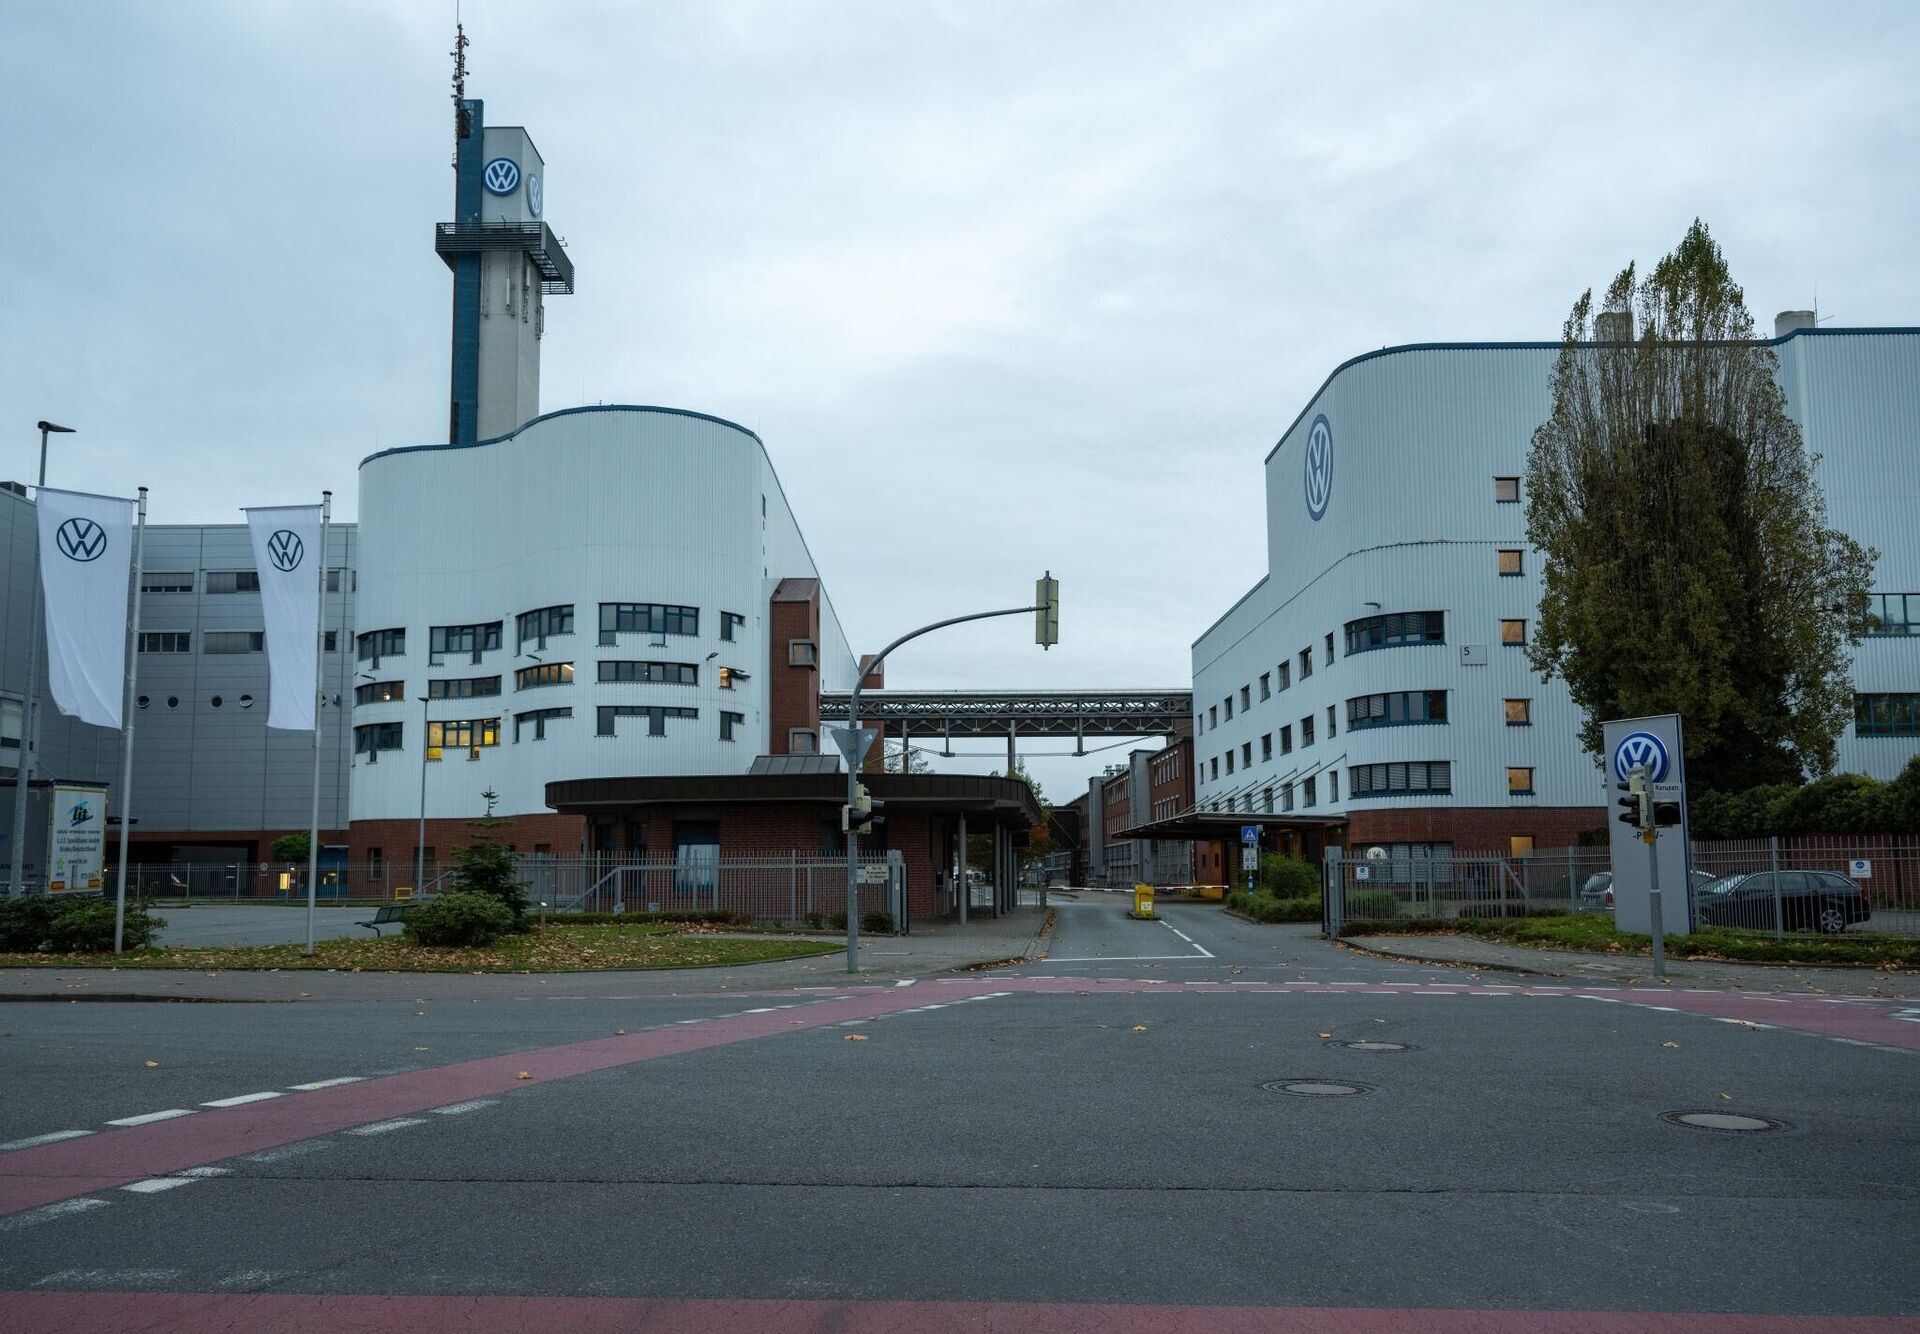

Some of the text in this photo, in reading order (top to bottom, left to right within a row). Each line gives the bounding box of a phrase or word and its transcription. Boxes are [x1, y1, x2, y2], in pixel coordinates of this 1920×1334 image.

[485, 160, 519, 193] VW
[1306, 421, 1331, 513] VW
[57, 518, 107, 562] VW
[268, 530, 304, 572] VW
[1463, 646, 1470, 656] 5
[1617, 736, 1663, 784] VW
